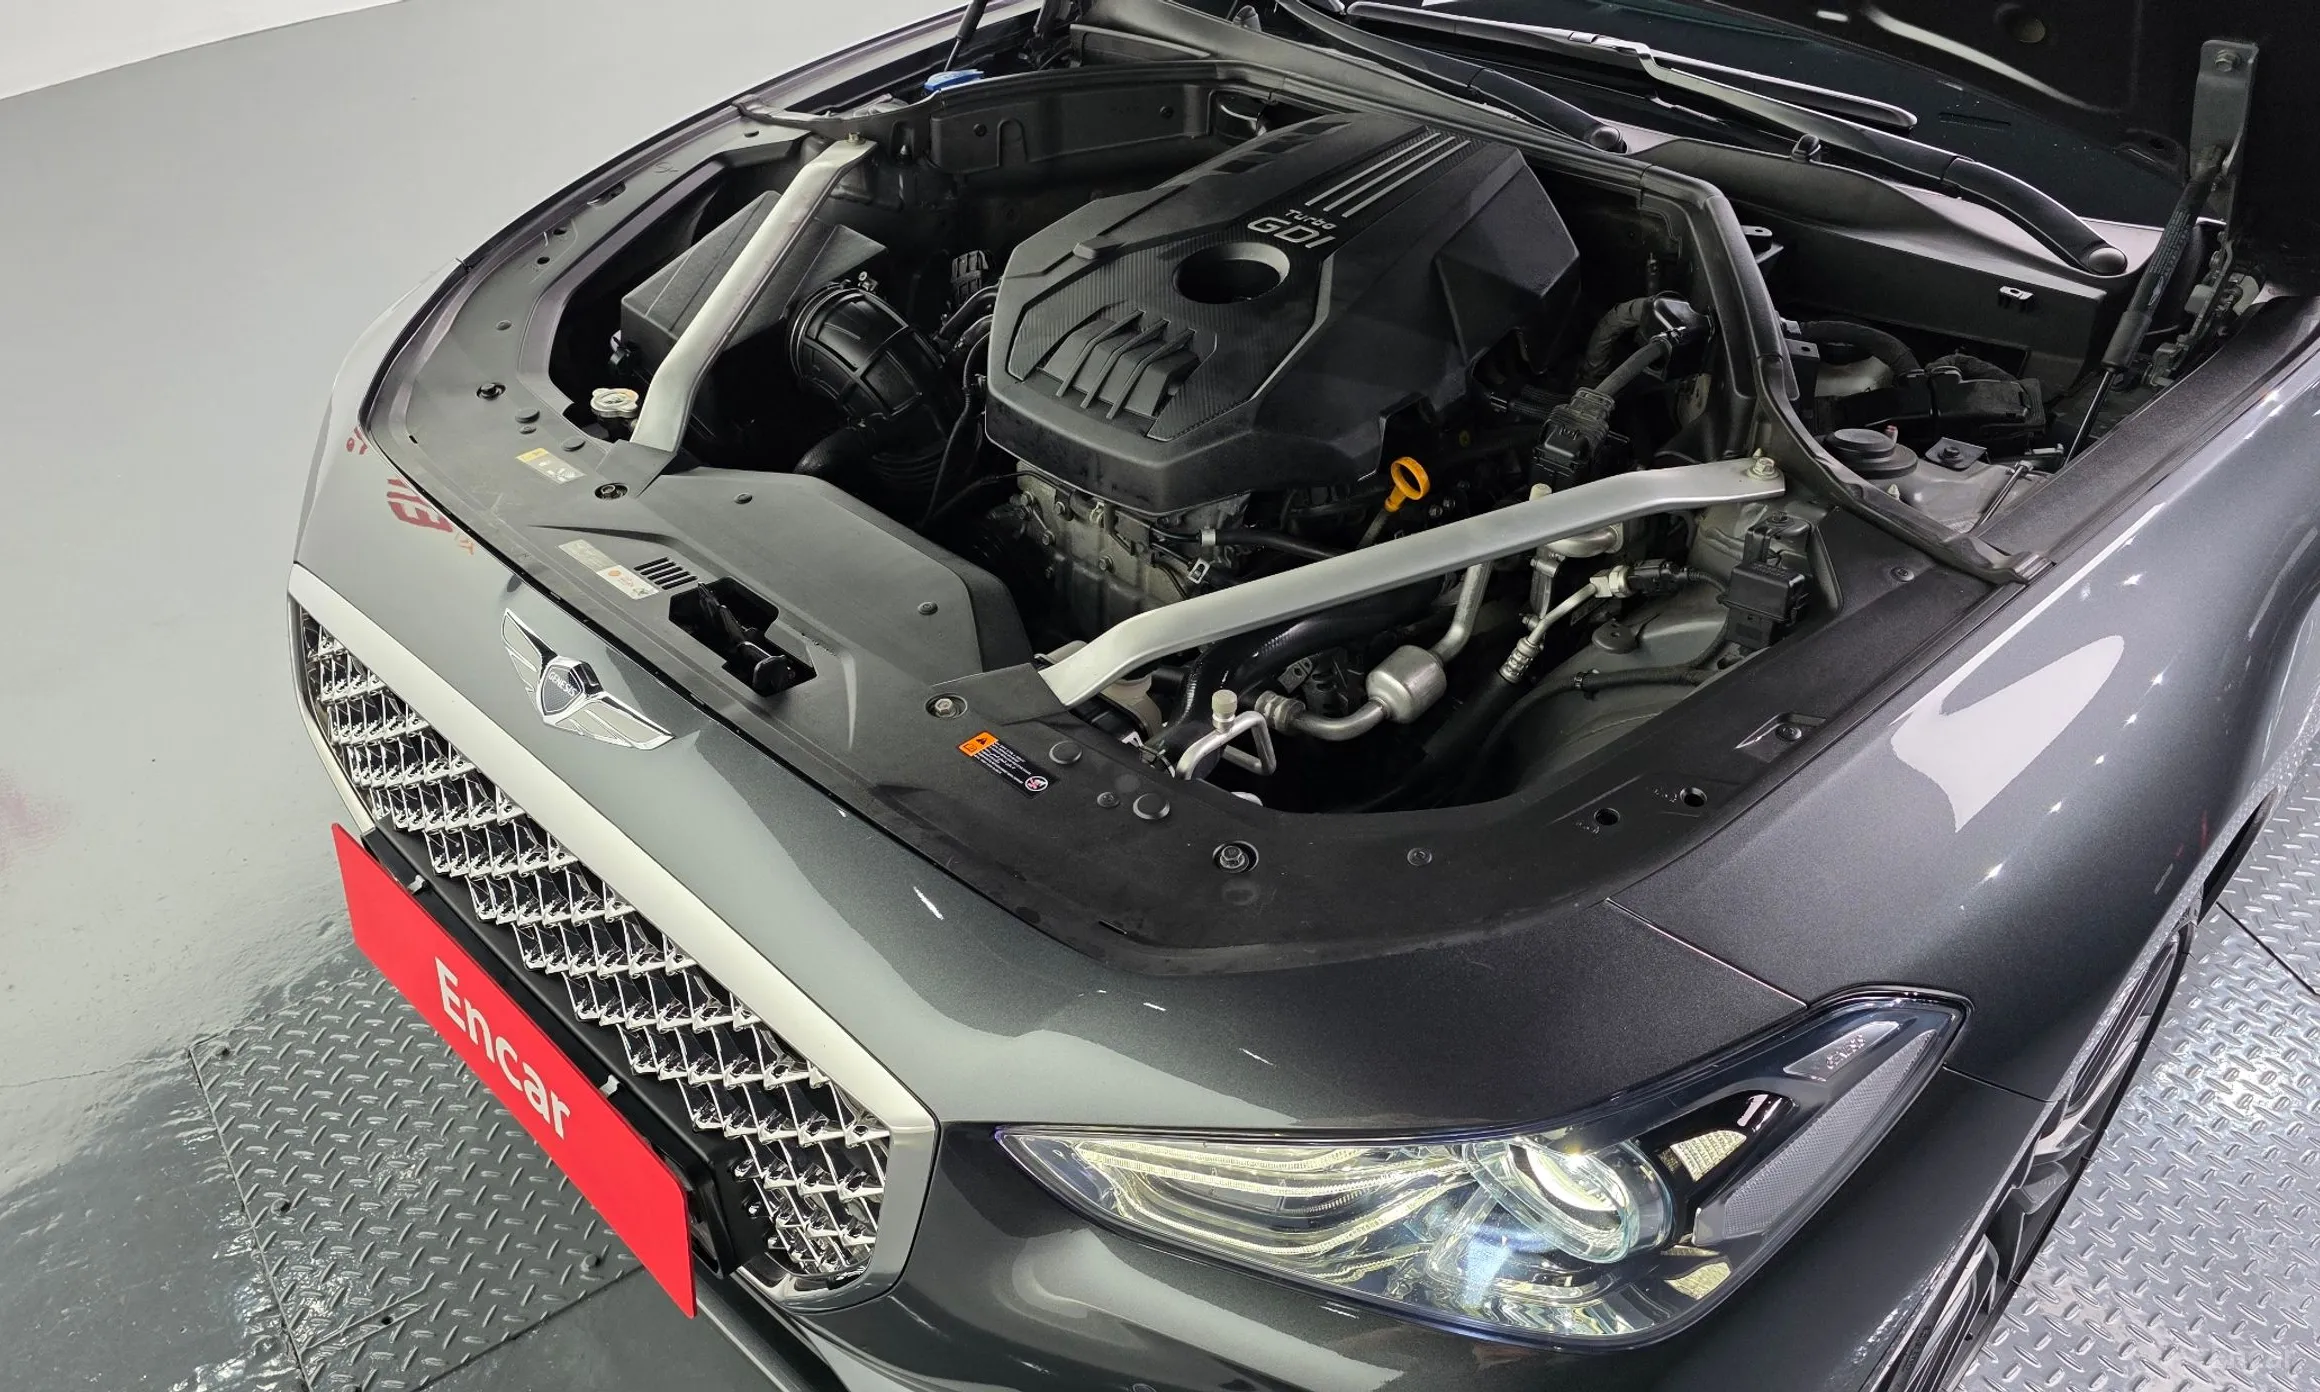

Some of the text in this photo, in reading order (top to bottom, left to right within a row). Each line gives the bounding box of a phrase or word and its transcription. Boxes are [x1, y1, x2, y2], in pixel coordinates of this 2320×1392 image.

[1247, 216, 1336, 249] GDI
[1285, 209, 1337, 230] Turbo
[548, 671, 578, 697] GENESIS
[434, 956, 571, 1140] Encar
